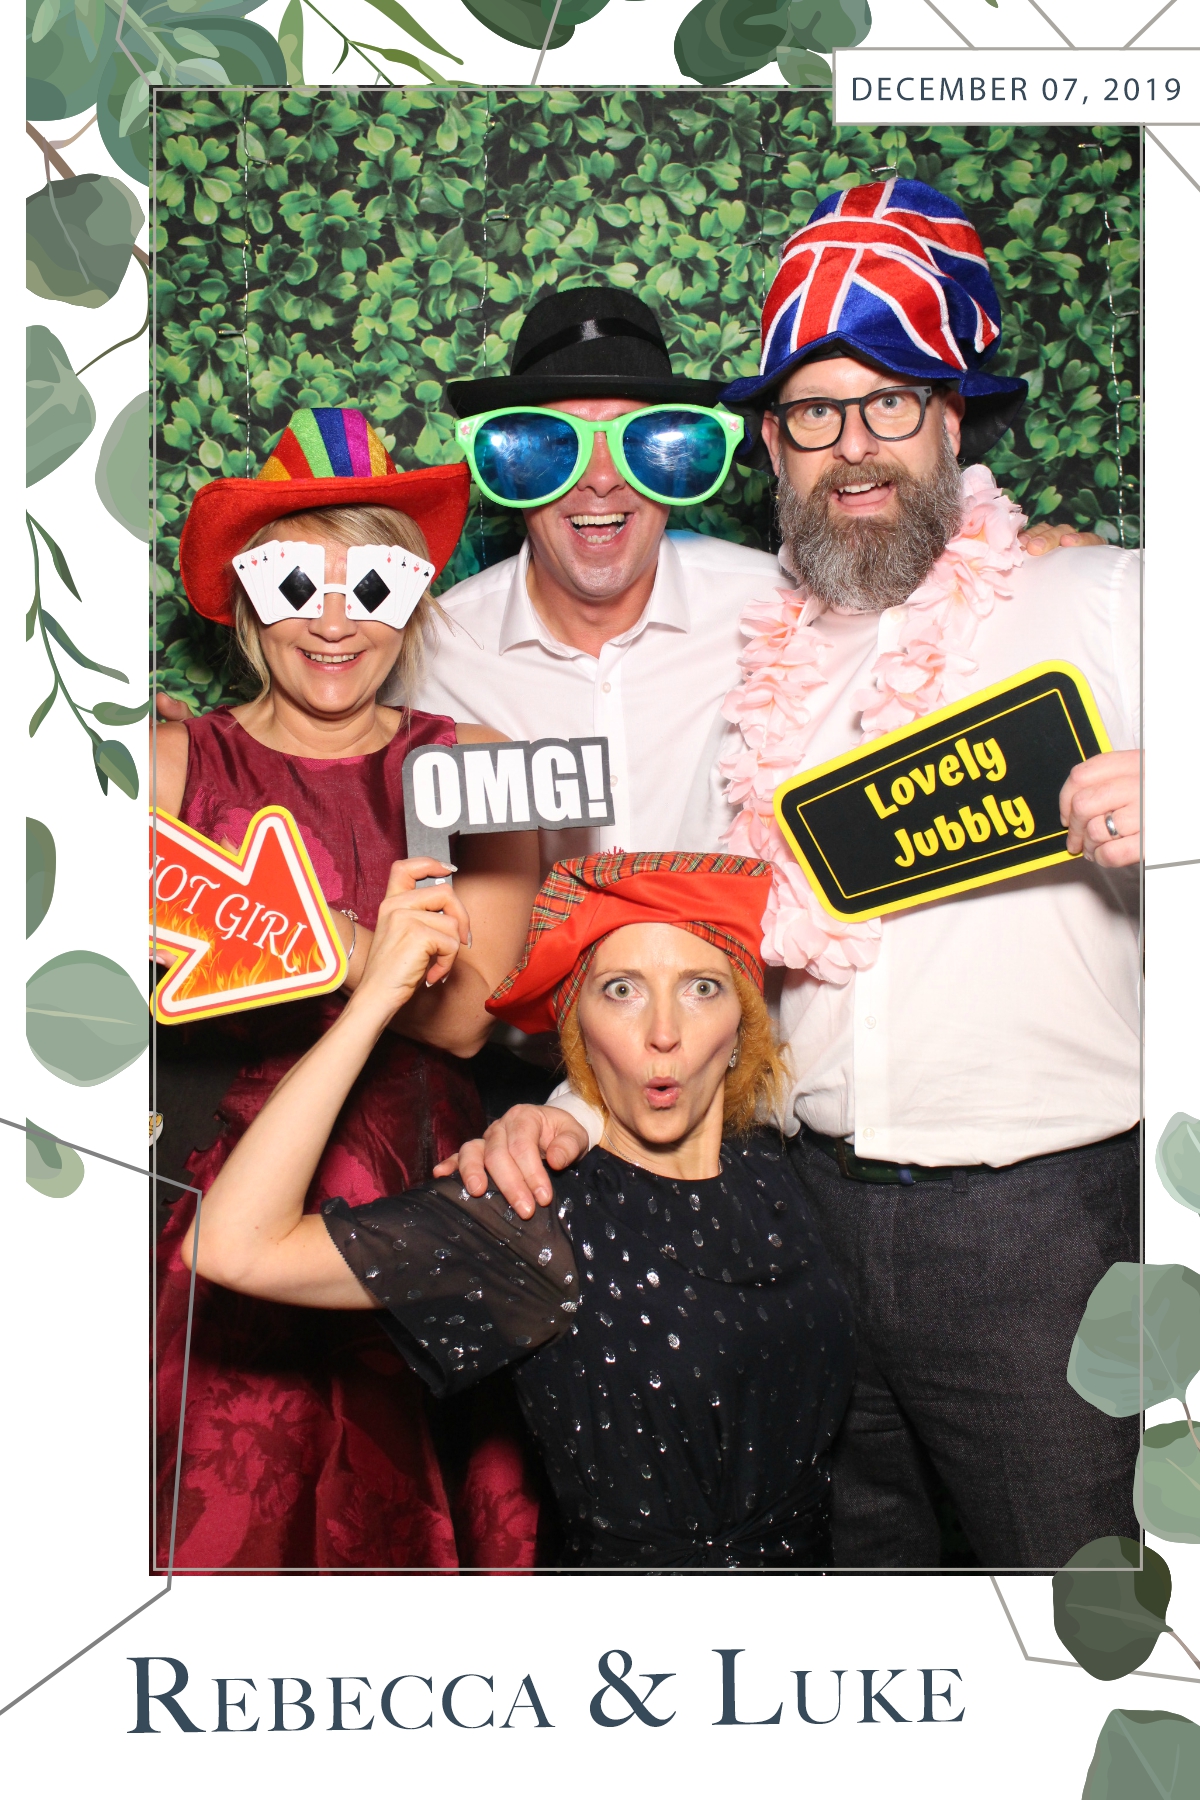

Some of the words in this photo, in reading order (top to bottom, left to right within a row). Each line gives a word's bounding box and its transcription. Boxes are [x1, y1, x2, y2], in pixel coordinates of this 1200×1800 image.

[412, 744, 608, 829] OMG!
[864, 736, 1007, 820] Lovely
[894, 795, 1035, 868] Jubbly
[214, 893, 308, 974] GIRL
